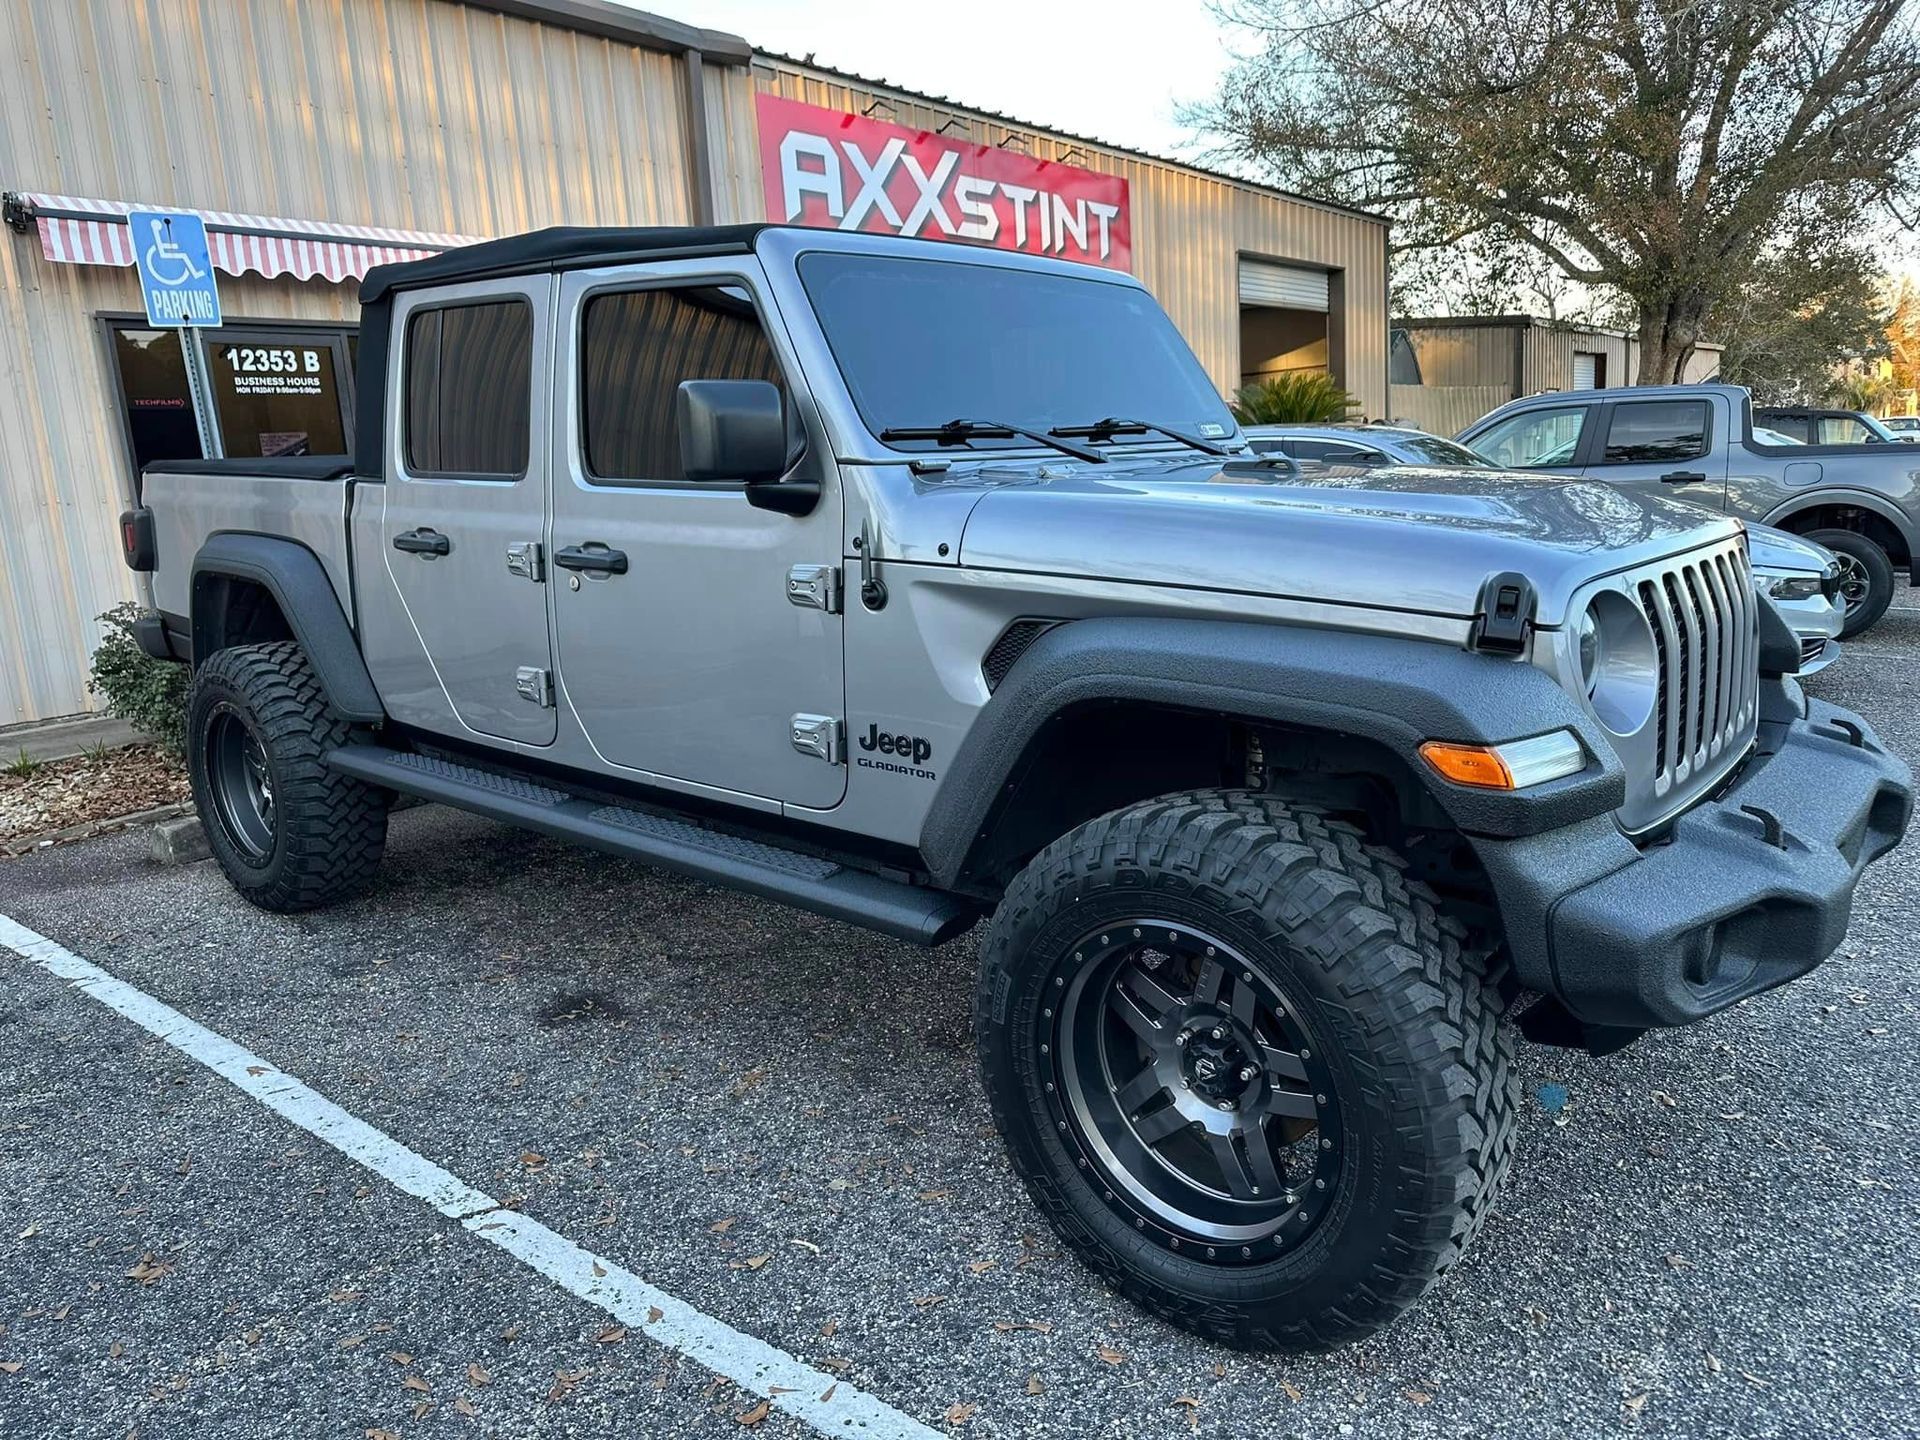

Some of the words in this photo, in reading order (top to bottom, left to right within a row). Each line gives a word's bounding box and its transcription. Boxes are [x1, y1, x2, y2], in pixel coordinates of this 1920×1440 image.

[151, 289, 214, 319] PARKING
[227, 348, 298, 372] 12353
[303, 350, 320, 372] B
[234, 376, 285, 386] BUSINESS
[286, 376, 320, 386] HOURS
[236, 386, 251, 394] MON
[252, 386, 275, 394] FRIDAY
[859, 722, 931, 765] Jeep
[857, 757, 937, 781] GLADIATOR
